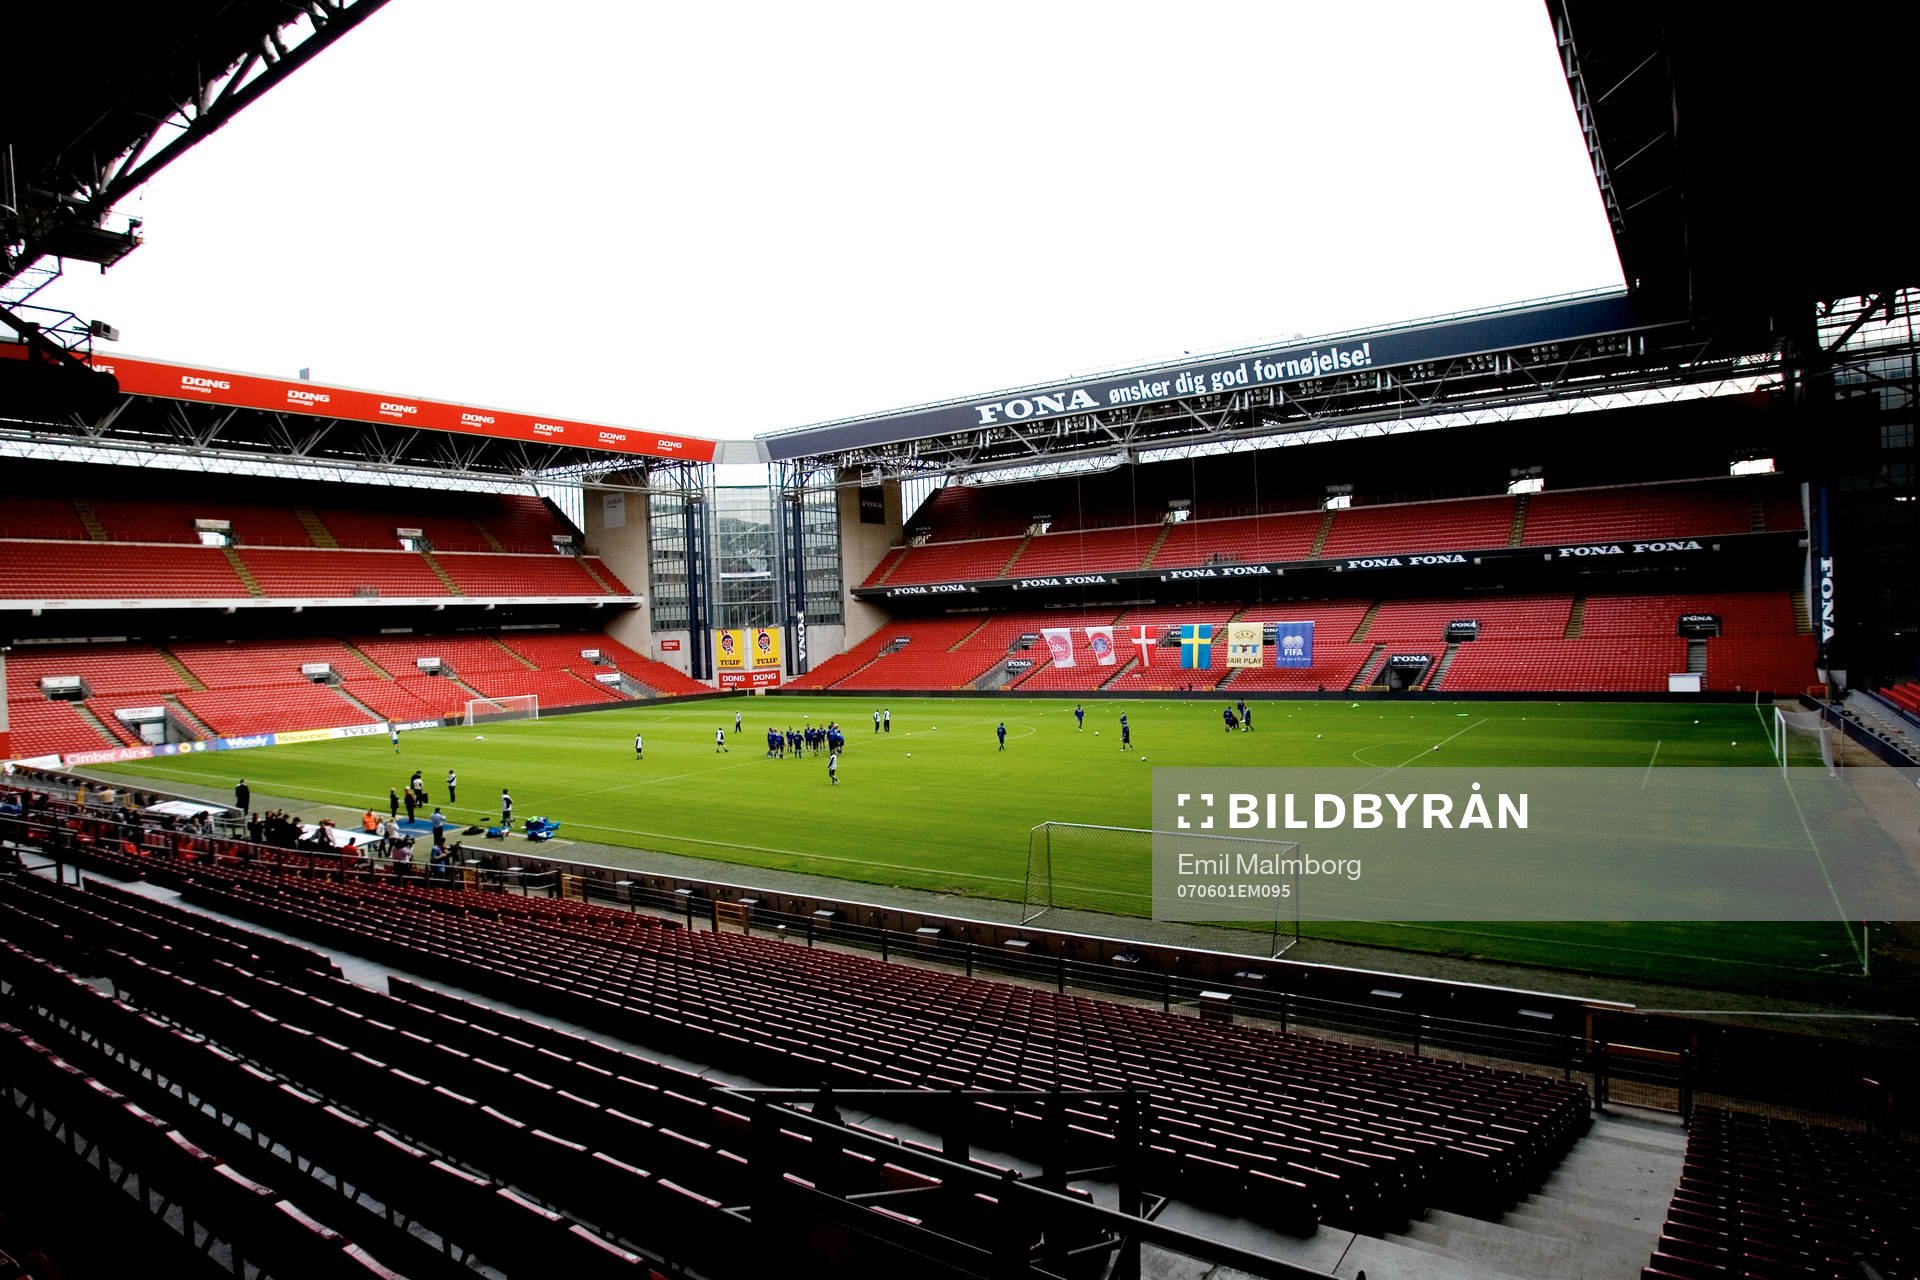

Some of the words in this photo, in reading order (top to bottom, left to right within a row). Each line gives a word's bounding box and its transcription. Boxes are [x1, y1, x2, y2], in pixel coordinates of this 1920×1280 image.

[181, 375, 230, 390] DONG
[975, 389, 1099, 424] FONA
[1109, 379, 1171, 404] ønsker
[1175, 372, 1206, 394] dig
[1211, 362, 1248, 391] god
[1253, 342, 1372, 381] fornøjelse!
[287, 389, 330, 403] DONG
[380, 402, 418, 414] DONG
[461, 413, 495, 424] DONG
[534, 422, 564, 433] DONG
[599, 431, 626, 441] DONG
[658, 439, 682, 449] DONG
[1559, 545, 1624, 557] FONA
[1632, 540, 1703, 553] FONA
[1348, 557, 1402, 569] FONA
[1409, 554, 1467, 565] FONA
[1171, 568, 1217, 579] FONA
[1222, 565, 1271, 576] FONA
[1020, 578, 1061, 588] FONA
[1064, 575, 1107, 585] FONA
[894, 586, 927, 595] FONA
[931, 584, 966, 593] FONA
[1820, 556, 1835, 643] FONA
[797, 611, 807, 661] FONA
[752, 673, 776, 681] DONG
[411, 720, 439, 729] adidas
[225, 735, 268, 748] Woody
[66, 750, 115, 765] Cimber
[120, 749, 137, 760] Air
